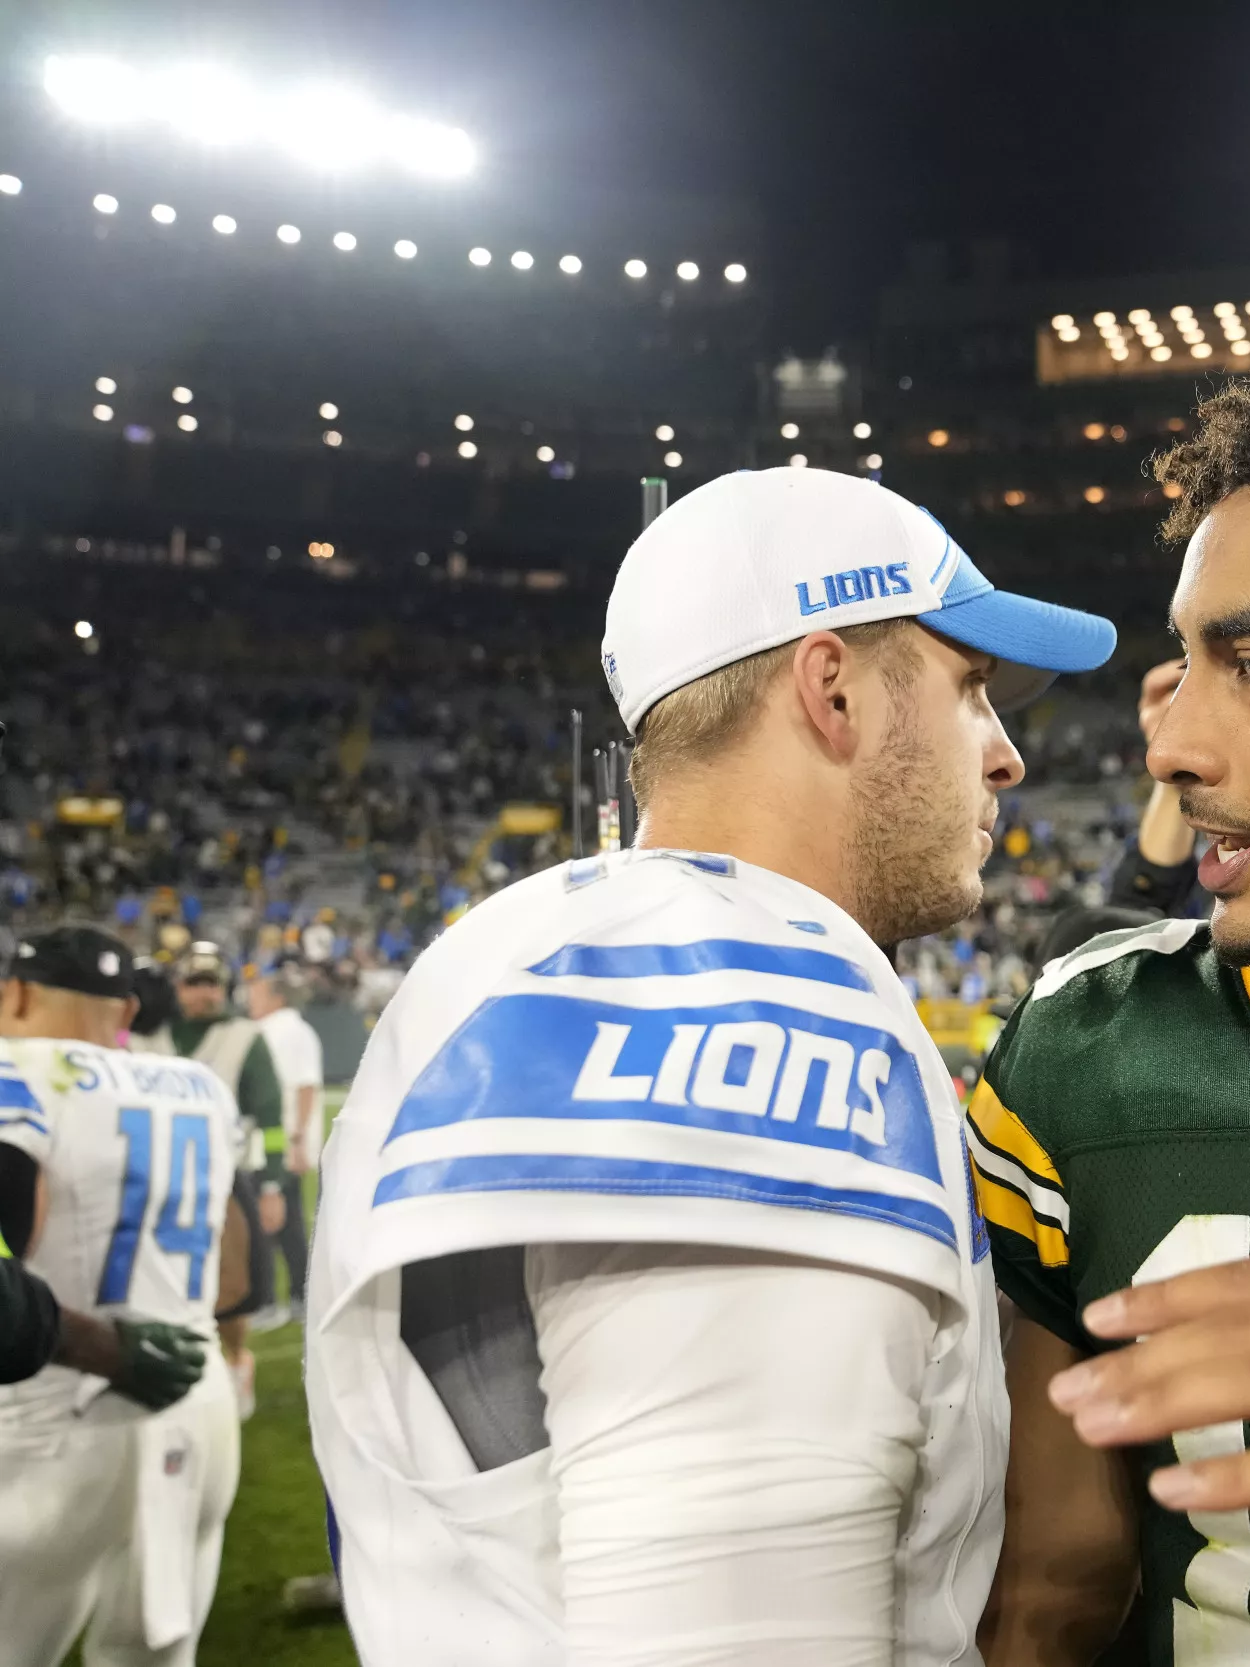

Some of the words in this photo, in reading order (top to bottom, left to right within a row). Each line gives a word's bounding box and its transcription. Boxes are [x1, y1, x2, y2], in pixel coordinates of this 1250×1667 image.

[795, 561, 913, 616] LIONS
[572, 1021, 891, 1146] LIONS
[96, 1107, 214, 1306] 14
